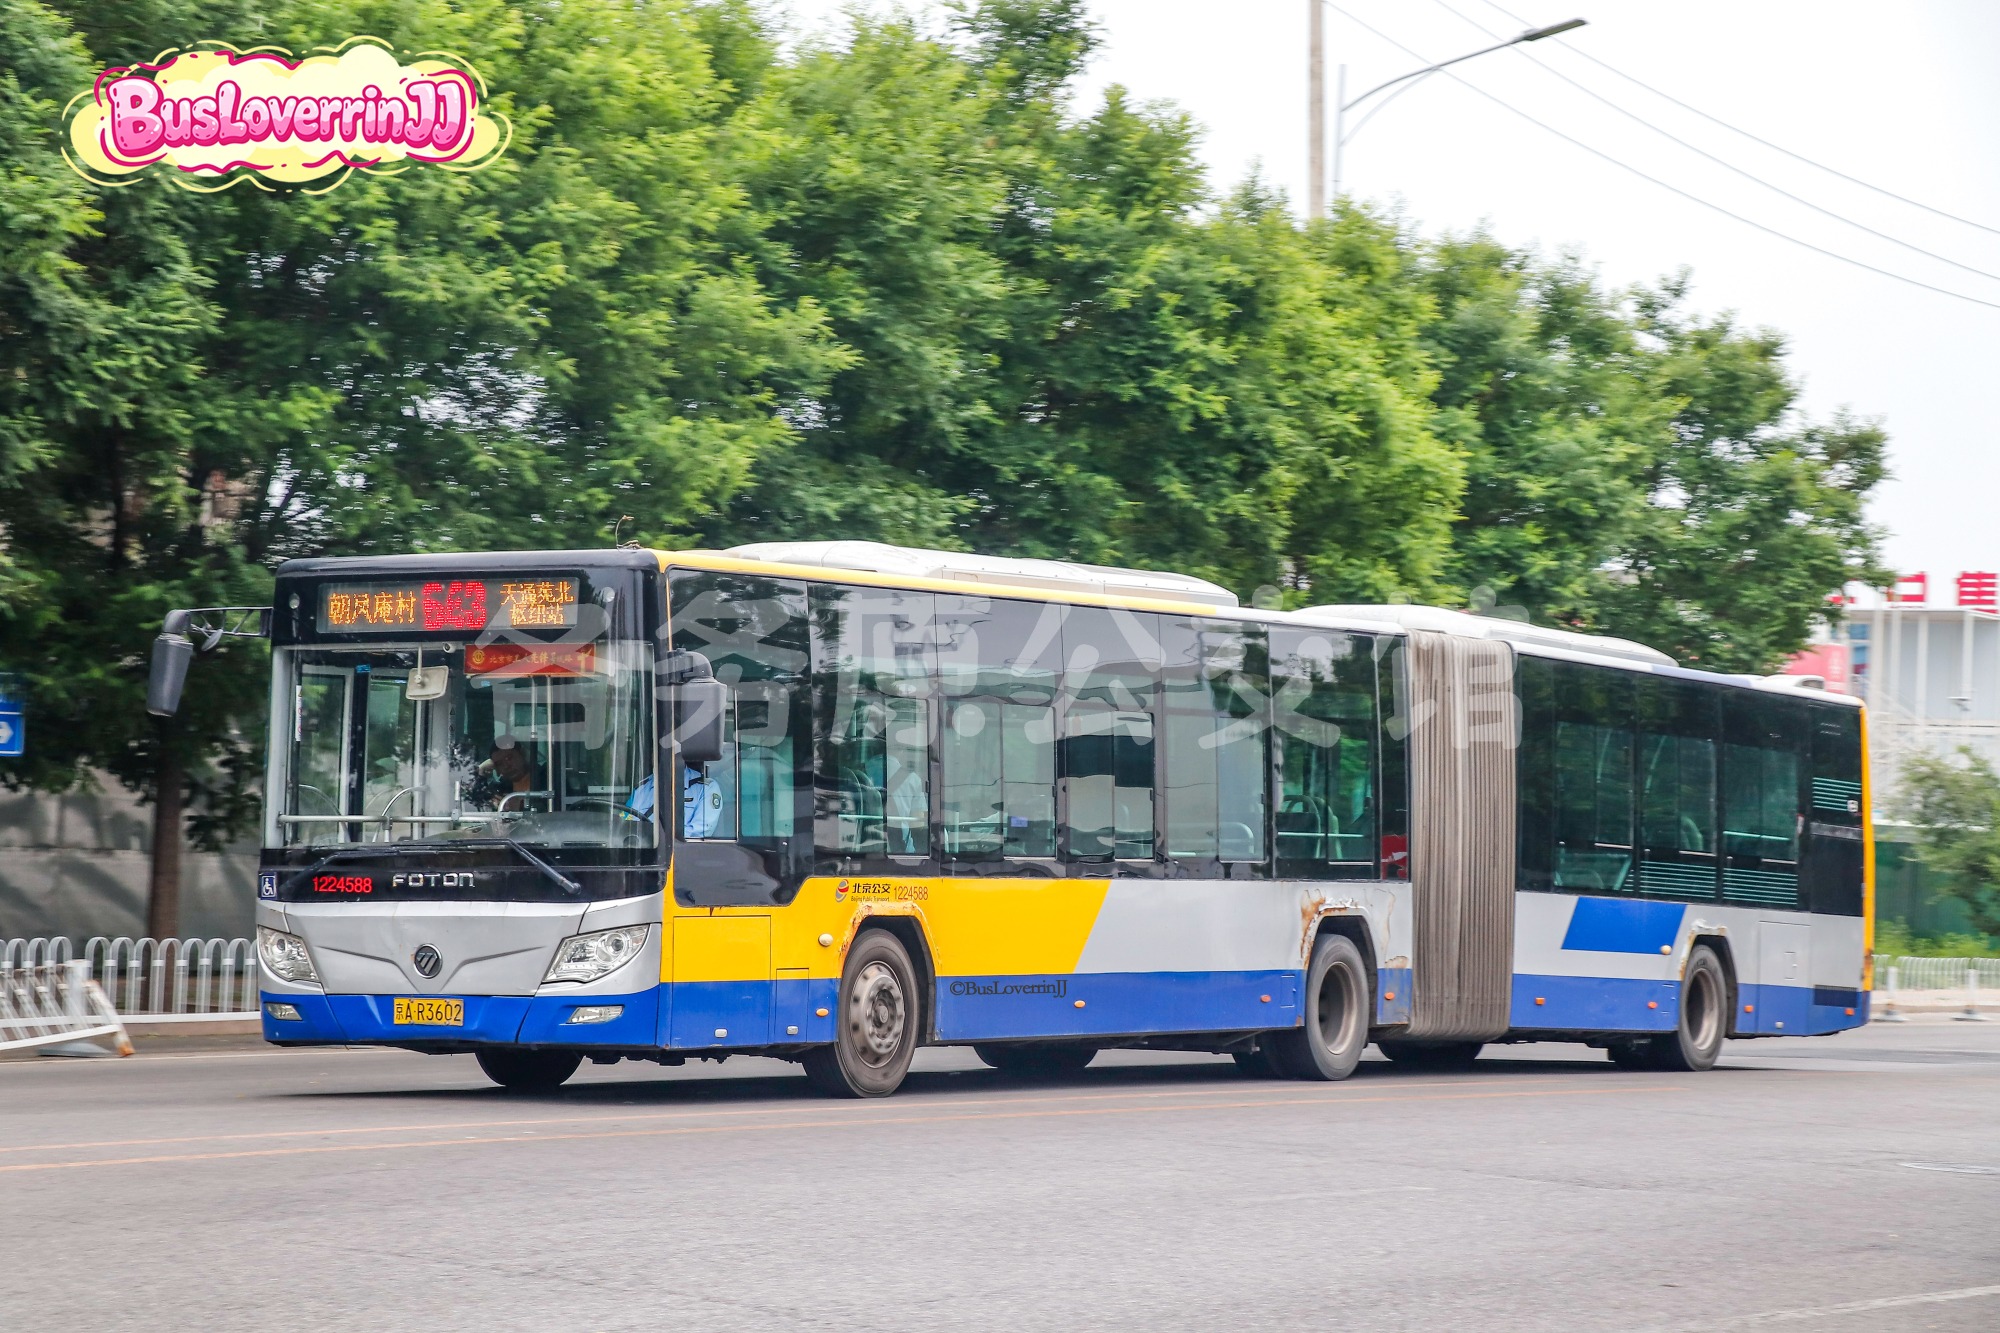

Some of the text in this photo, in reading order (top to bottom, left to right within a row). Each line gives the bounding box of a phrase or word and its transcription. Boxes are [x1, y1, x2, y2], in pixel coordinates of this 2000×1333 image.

[500, 581, 575, 605] 天通苑北
[422, 581, 487, 630] 643
[510, 603, 564, 626] 枢纽站
[312, 876, 373, 893] 1224588
[392, 873, 475, 887] FOTON
[852, 883, 891, 894] 北京公交
[894, 886, 929, 901] 1224588
